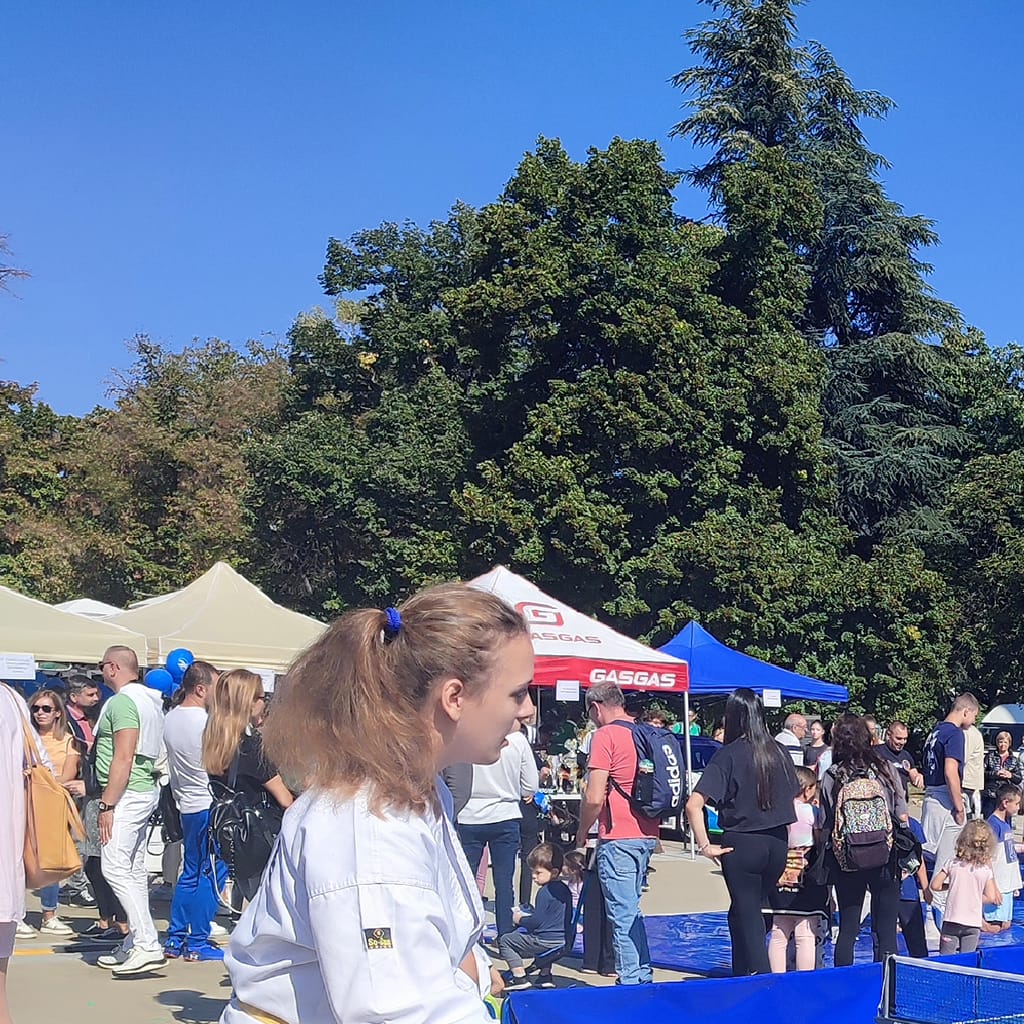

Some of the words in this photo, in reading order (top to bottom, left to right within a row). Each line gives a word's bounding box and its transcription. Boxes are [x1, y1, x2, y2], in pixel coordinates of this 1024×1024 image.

[531, 632, 602, 644] ASGAS
[589, 669, 677, 688] GASGAS
[662, 744, 681, 808] adidas
